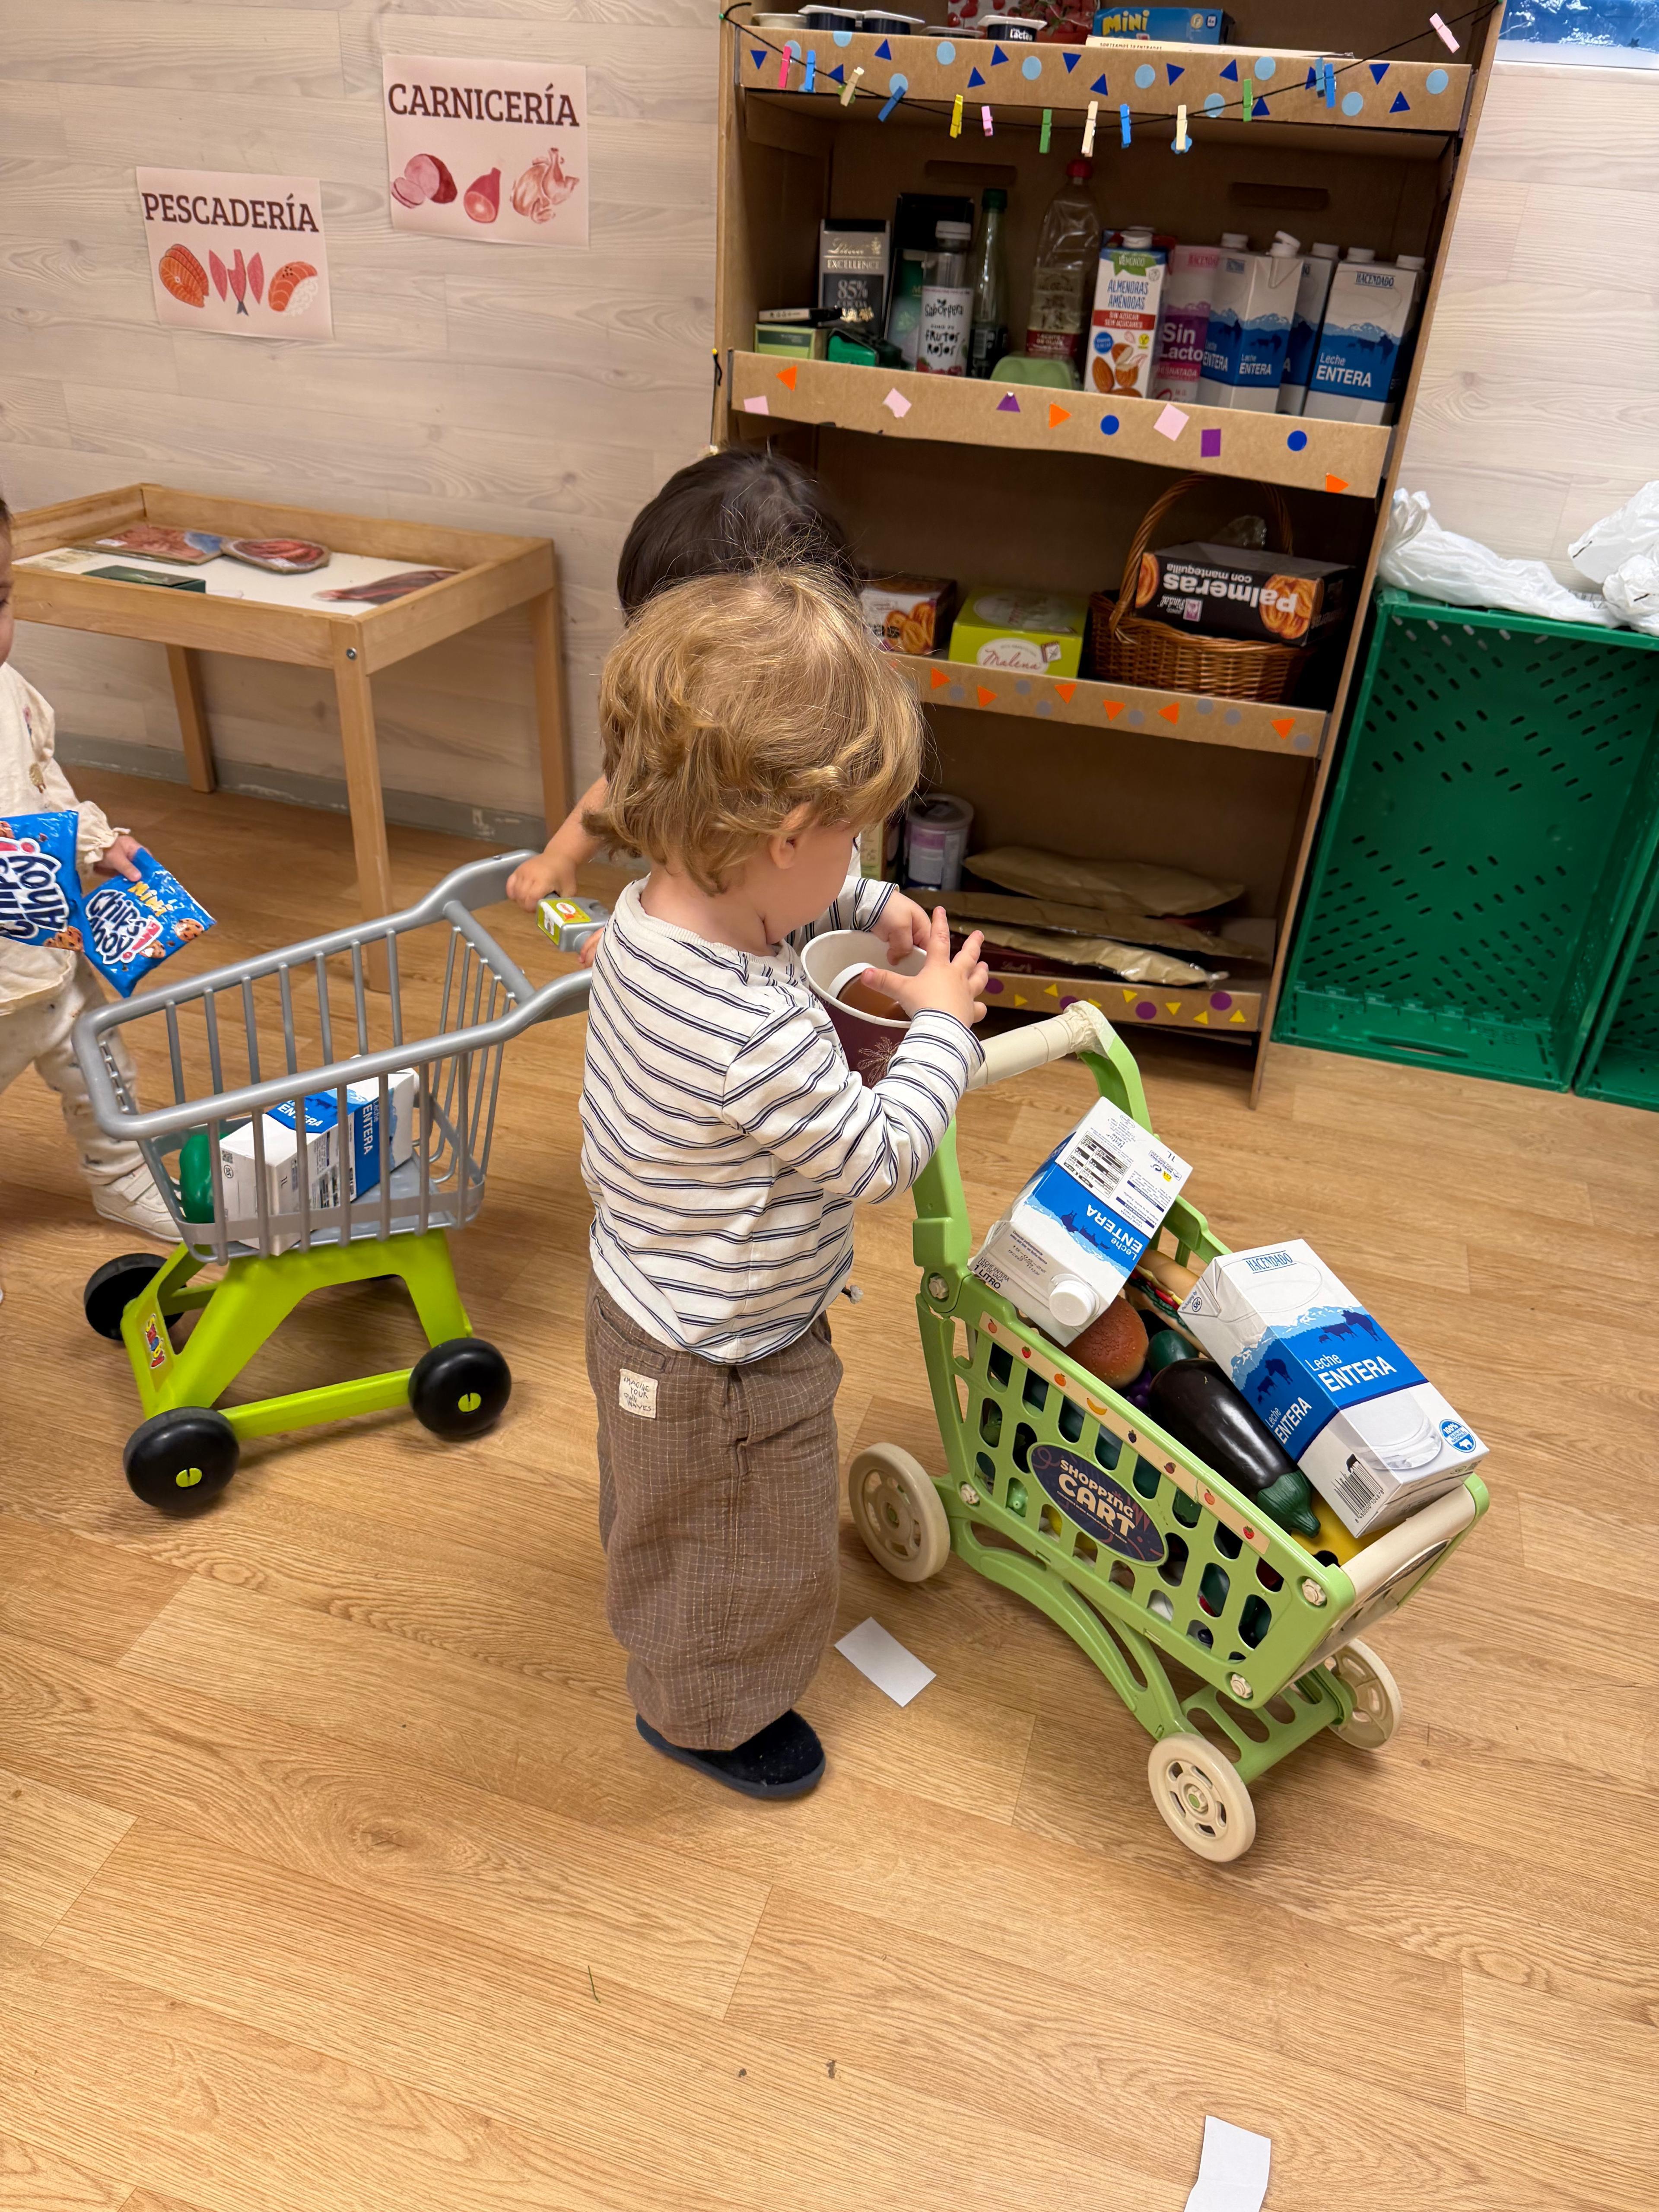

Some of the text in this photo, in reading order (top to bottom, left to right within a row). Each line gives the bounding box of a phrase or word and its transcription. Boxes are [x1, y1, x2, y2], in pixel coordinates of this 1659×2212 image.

[388, 83, 580, 127] CARNICERÍA
[141, 193, 319, 233] PESCADERÍA
[827, 259, 879, 270] EXCELLENCE
[838, 280, 868, 299] 85%
[1107, 280, 1148, 295] ALMENDRAS
[1356, 272, 1395, 287] HACENDADO
[1163, 324, 1196, 344] Sin
[1202, 352, 1229, 372] ENTERA
[1239, 363, 1272, 375] ENTERA
[1320, 352, 1346, 366] Leche
[1316, 364, 1372, 388] ENTERA
[1166, 563, 1252, 583] con mantequilla
[1163, 572, 1297, 613] Palmeras
[88, 890, 147, 937] Chips
[276, 1104, 323, 1127] ENERA
[362, 1104, 374, 1155] ENTERA
[1087, 1204, 1143, 1252] ENTERA
[1111, 1238, 1138, 1261] Leche
[977, 1259, 988, 1269] UHT
[992, 1271, 1004, 1283] VACA
[1246, 1252, 1293, 1271] HACENDADO
[977, 1268, 1002, 1290] LITRO
[992, 1267, 1010, 1282] ENTERA
[1304, 1352, 1342, 1372] Leche
[1317, 1355, 1397, 1393] ENTERA
[624, 1377, 649, 1392] IMAGINE
[630, 1387, 648, 1399] YOUR
[624, 1393, 637, 1403] OWN
[627, 1400, 652, 1411] WAVES
[1265, 1408, 1281, 1428] Leche
[1274, 1397, 1313, 1444] ENTERA
[1060, 1459, 1134, 1519] SHOPPING
[1058, 1473, 1136, 1537] CART
